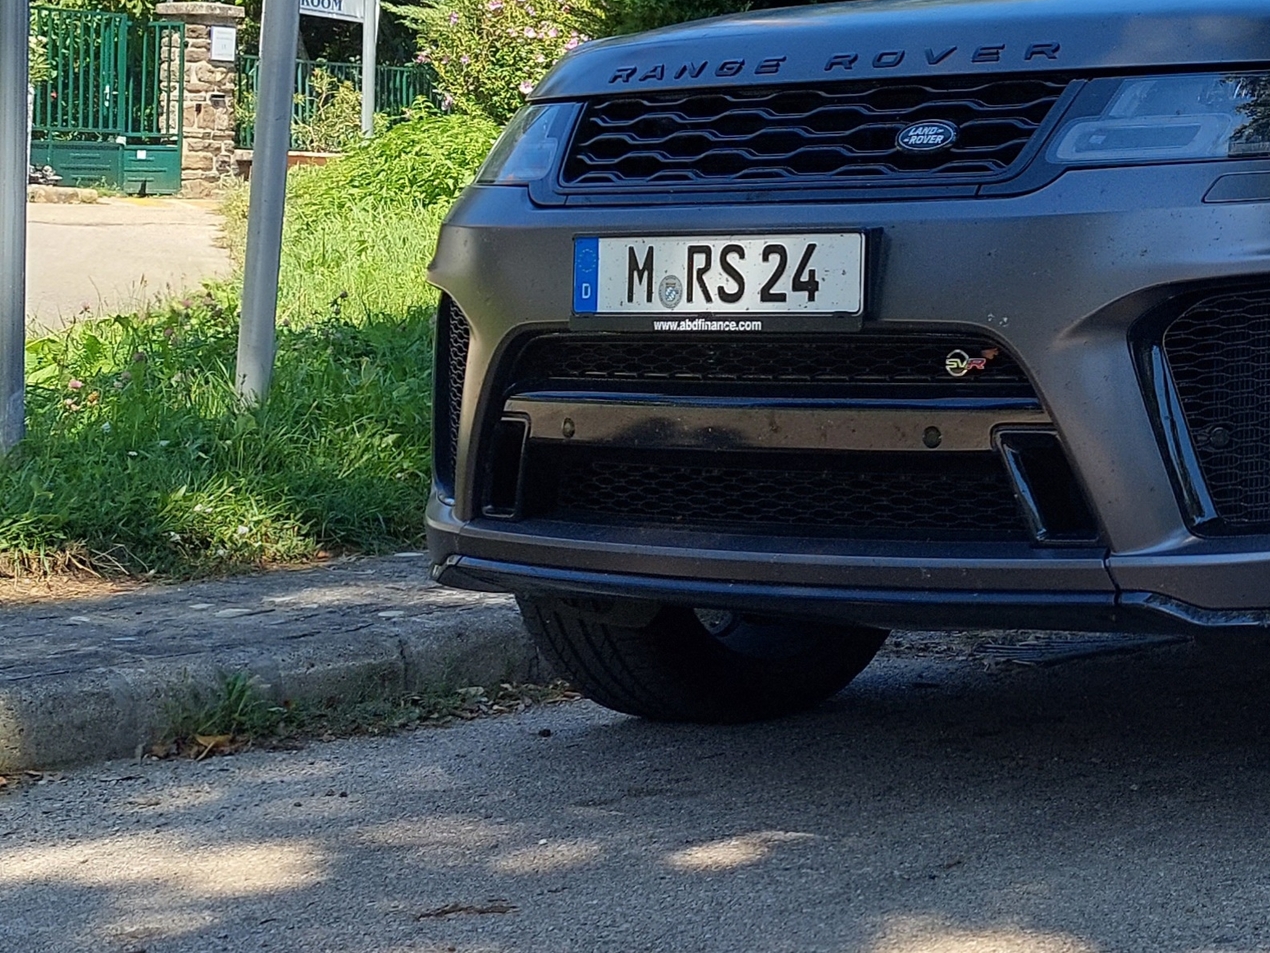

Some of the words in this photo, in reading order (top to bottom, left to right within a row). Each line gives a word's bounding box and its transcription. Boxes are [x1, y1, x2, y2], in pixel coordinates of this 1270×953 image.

[608, 55, 787, 84] RANGE
[823, 42, 1061, 72] ROVER
[627, 245, 654, 303] M
[686, 244, 746, 303] RS
[760, 243, 820, 302] 24
[582, 283, 591, 299] D
[654, 319, 762, 331] www.abdfinance.com
[945, 356, 987, 371] SVR
